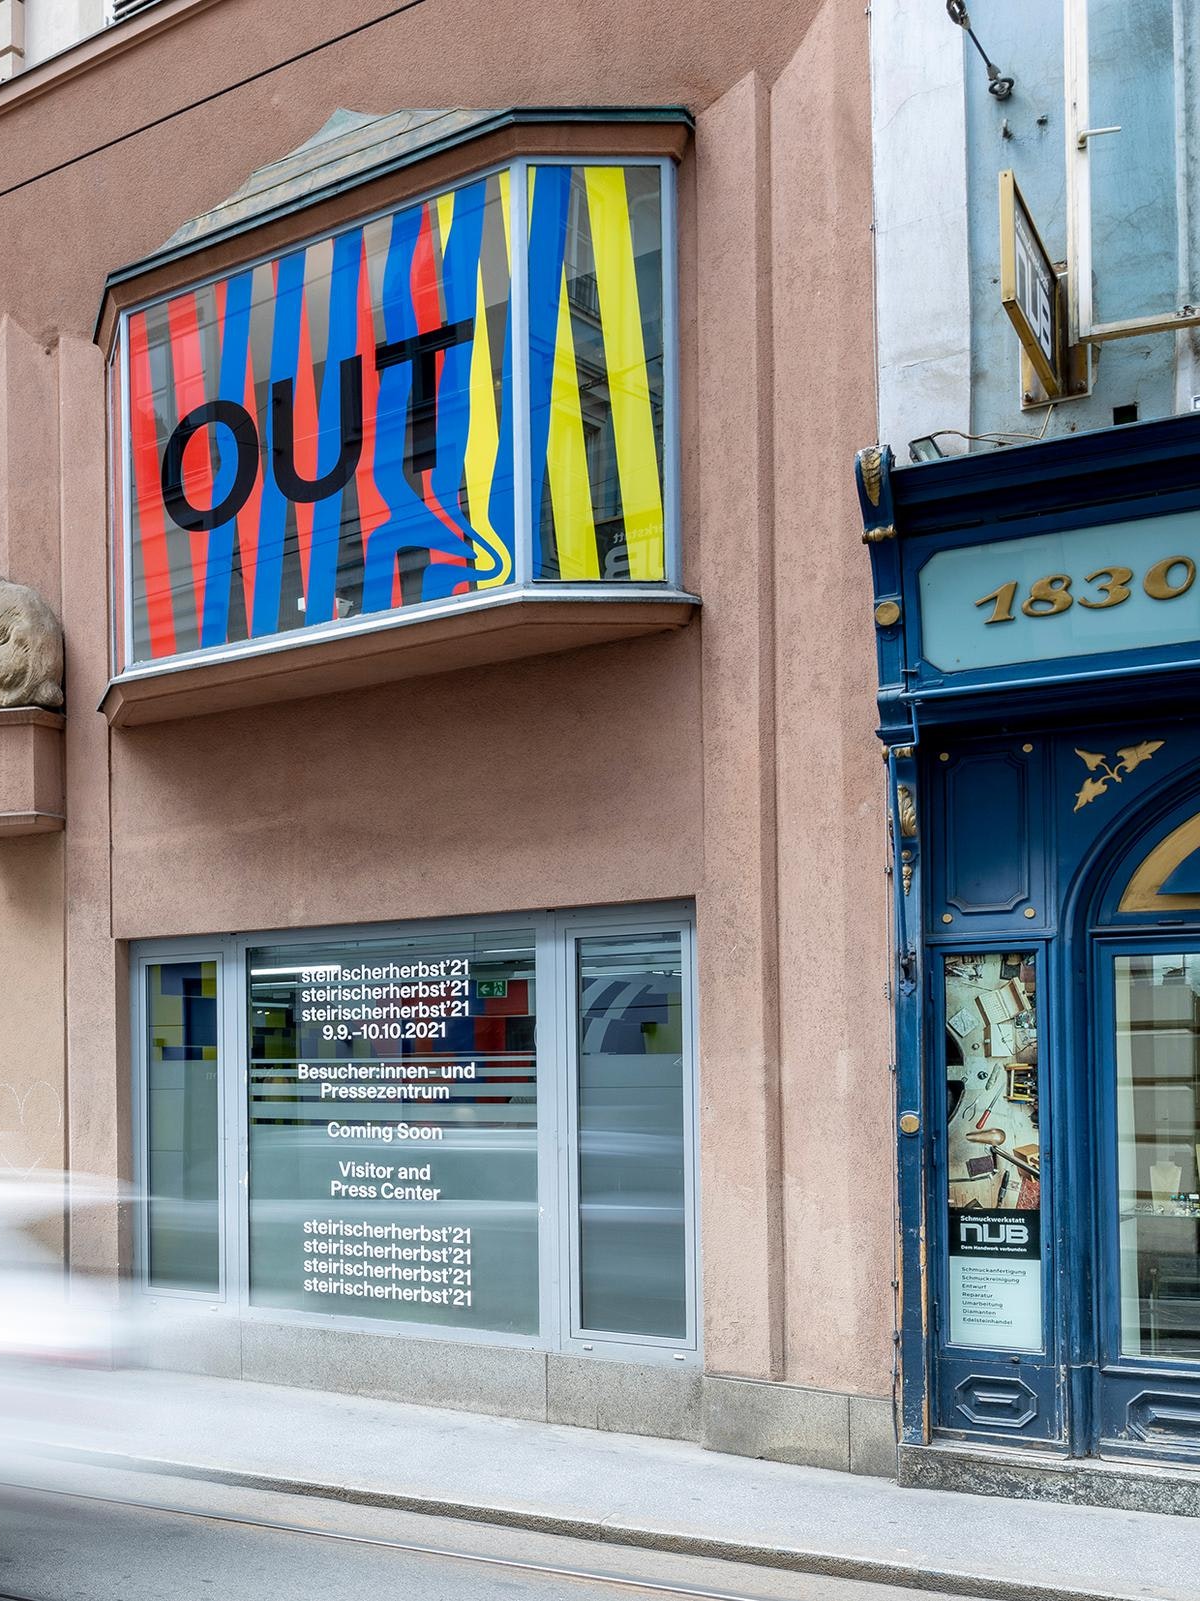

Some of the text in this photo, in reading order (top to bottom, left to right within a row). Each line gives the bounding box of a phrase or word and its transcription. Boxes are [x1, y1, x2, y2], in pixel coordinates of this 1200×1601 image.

[161, 317, 475, 532] OUT
[975, 555, 1196, 625] 1830
[301, 980, 469, 1003] steirischerherbst’21
[301, 1000, 469, 1022] steirischerherbst’21
[298, 1062, 436, 1080] Besucher:innen-
[441, 1062, 476, 1079] und
[321, 1083, 450, 1100] Pressezentrum
[327, 1122, 443, 1142] Coming Soon
[338, 1161, 431, 1181] Visitor and
[330, 1180, 441, 1201] Press Center
[960, 1215, 1025, 1223] Schmuckwerkstatt
[303, 1218, 471, 1244] steirischerherbst’21
[303, 1239, 471, 1265] steirischerherbst’21
[303, 1258, 471, 1286] steirischerherbst’21
[962, 1266, 1026, 1275] Schmuckanfertigung
[962, 1275, 1020, 1283] Schmuckreinigung
[303, 1277, 472, 1307] steirischerherbst’21
[962, 1300, 1004, 1308] Umarbeitung
[962, 1317, 1013, 1325] Edelsteinhandel
